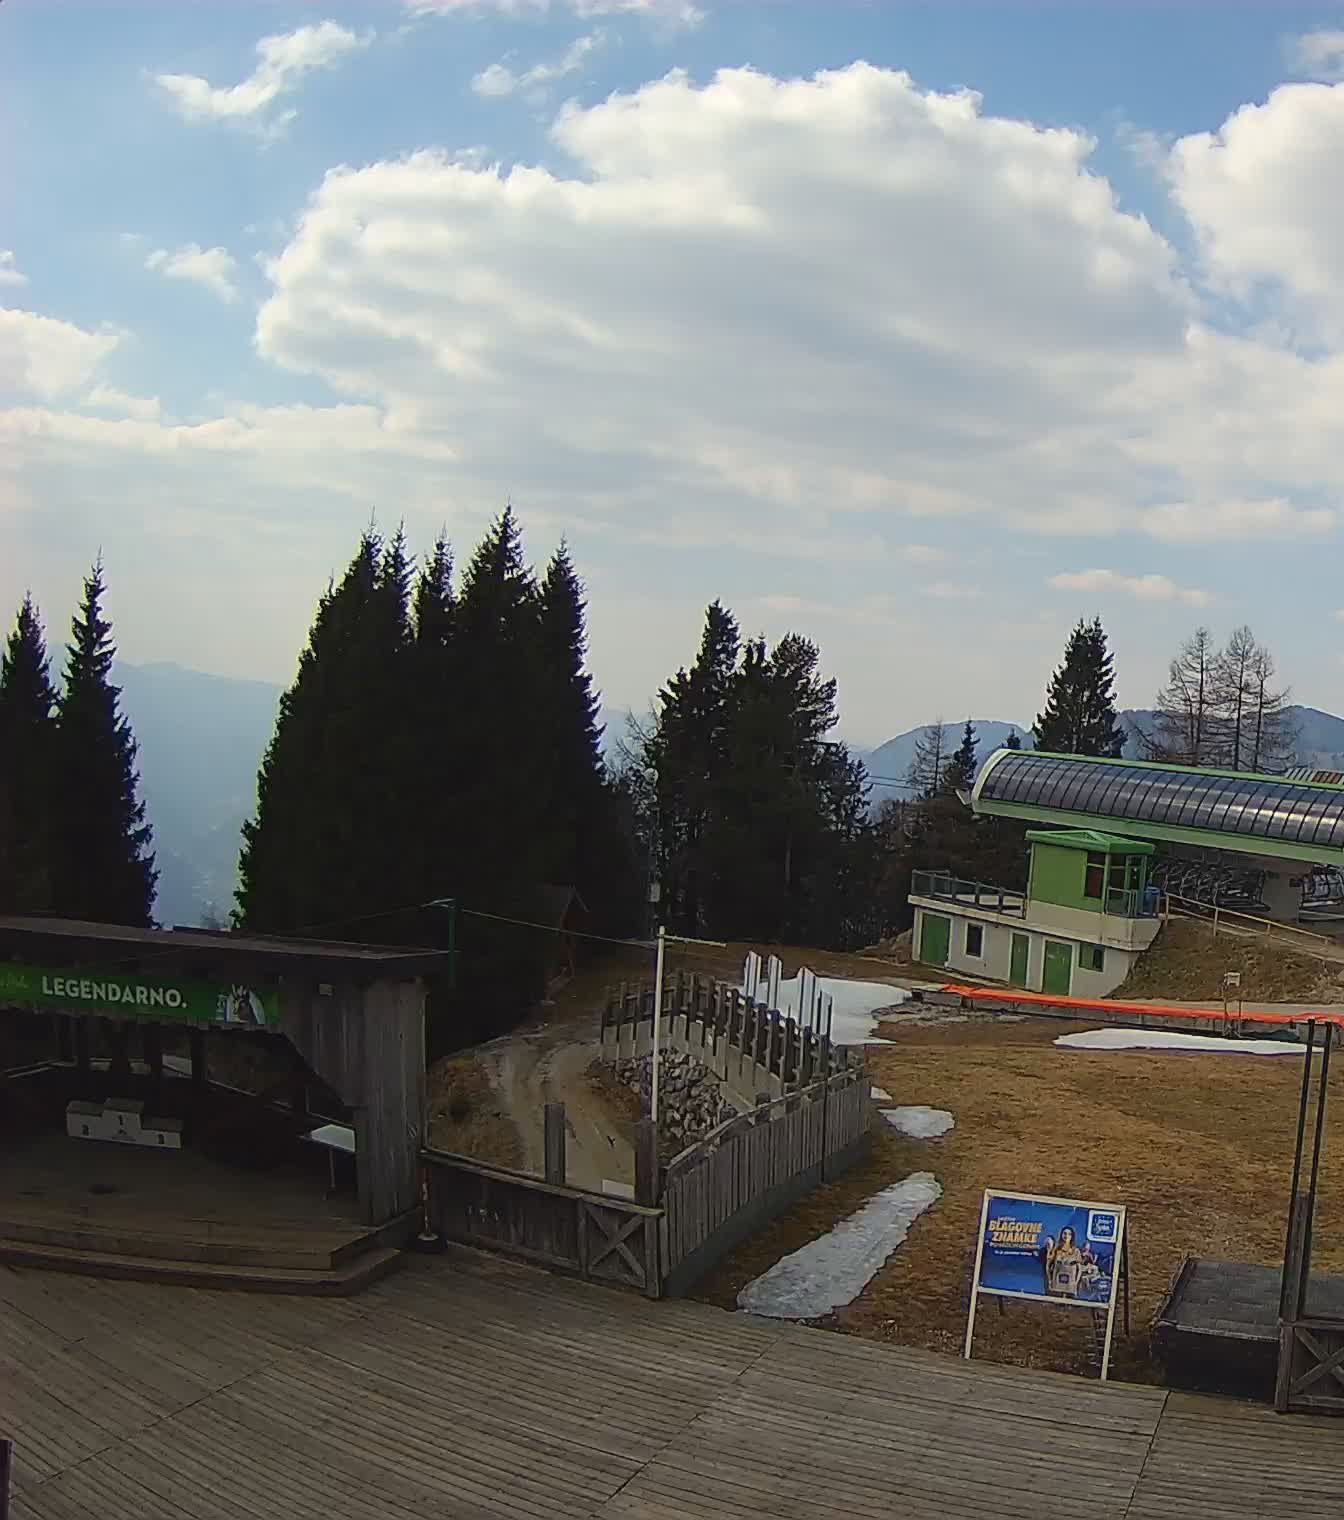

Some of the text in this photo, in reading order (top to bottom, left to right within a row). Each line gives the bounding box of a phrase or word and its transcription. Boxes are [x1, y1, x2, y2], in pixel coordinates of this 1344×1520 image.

[41, 975, 188, 1008] LEGENDARNO.
[989, 1220, 1042, 1232] BLAGOVNE
[991, 1231, 1038, 1243] ZNAMKE
